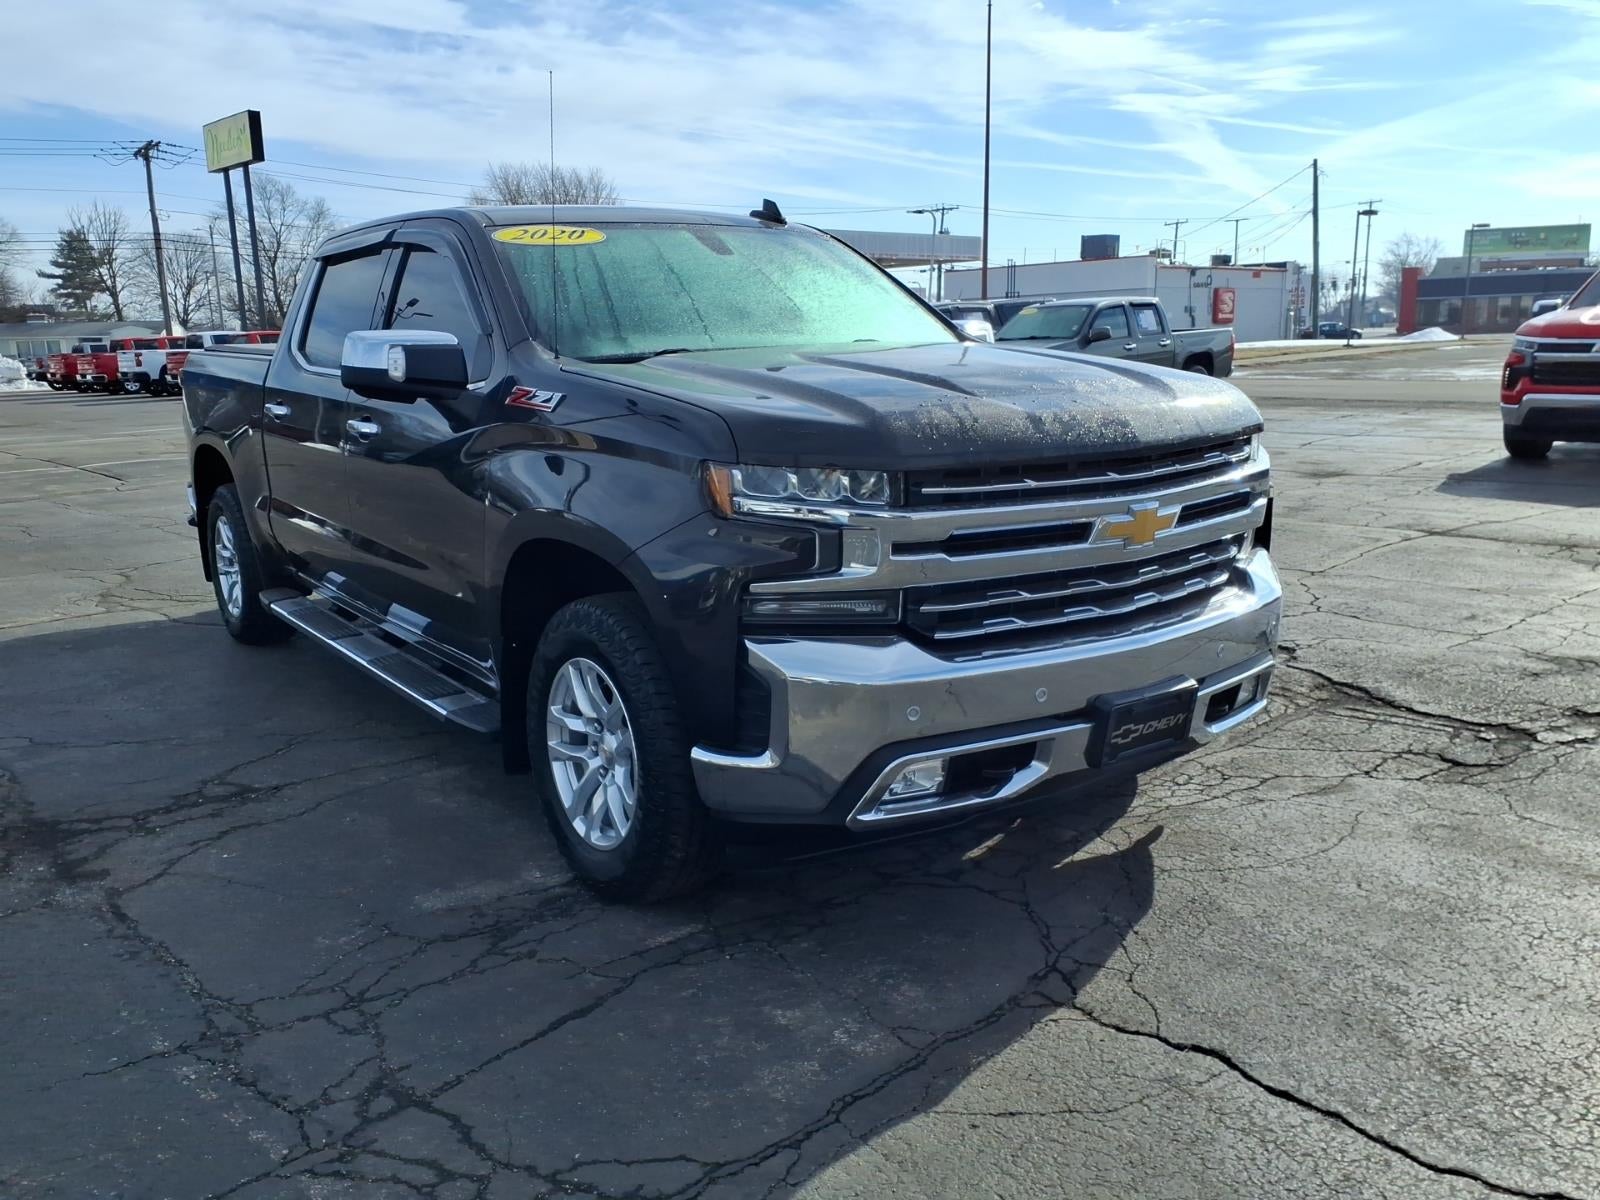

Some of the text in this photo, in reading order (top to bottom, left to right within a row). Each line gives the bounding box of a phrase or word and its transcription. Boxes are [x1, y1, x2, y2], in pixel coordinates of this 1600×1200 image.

[510, 229, 585, 240] 2020
[505, 386, 562, 411] Z71
[1142, 713, 1188, 734] CHEVY
